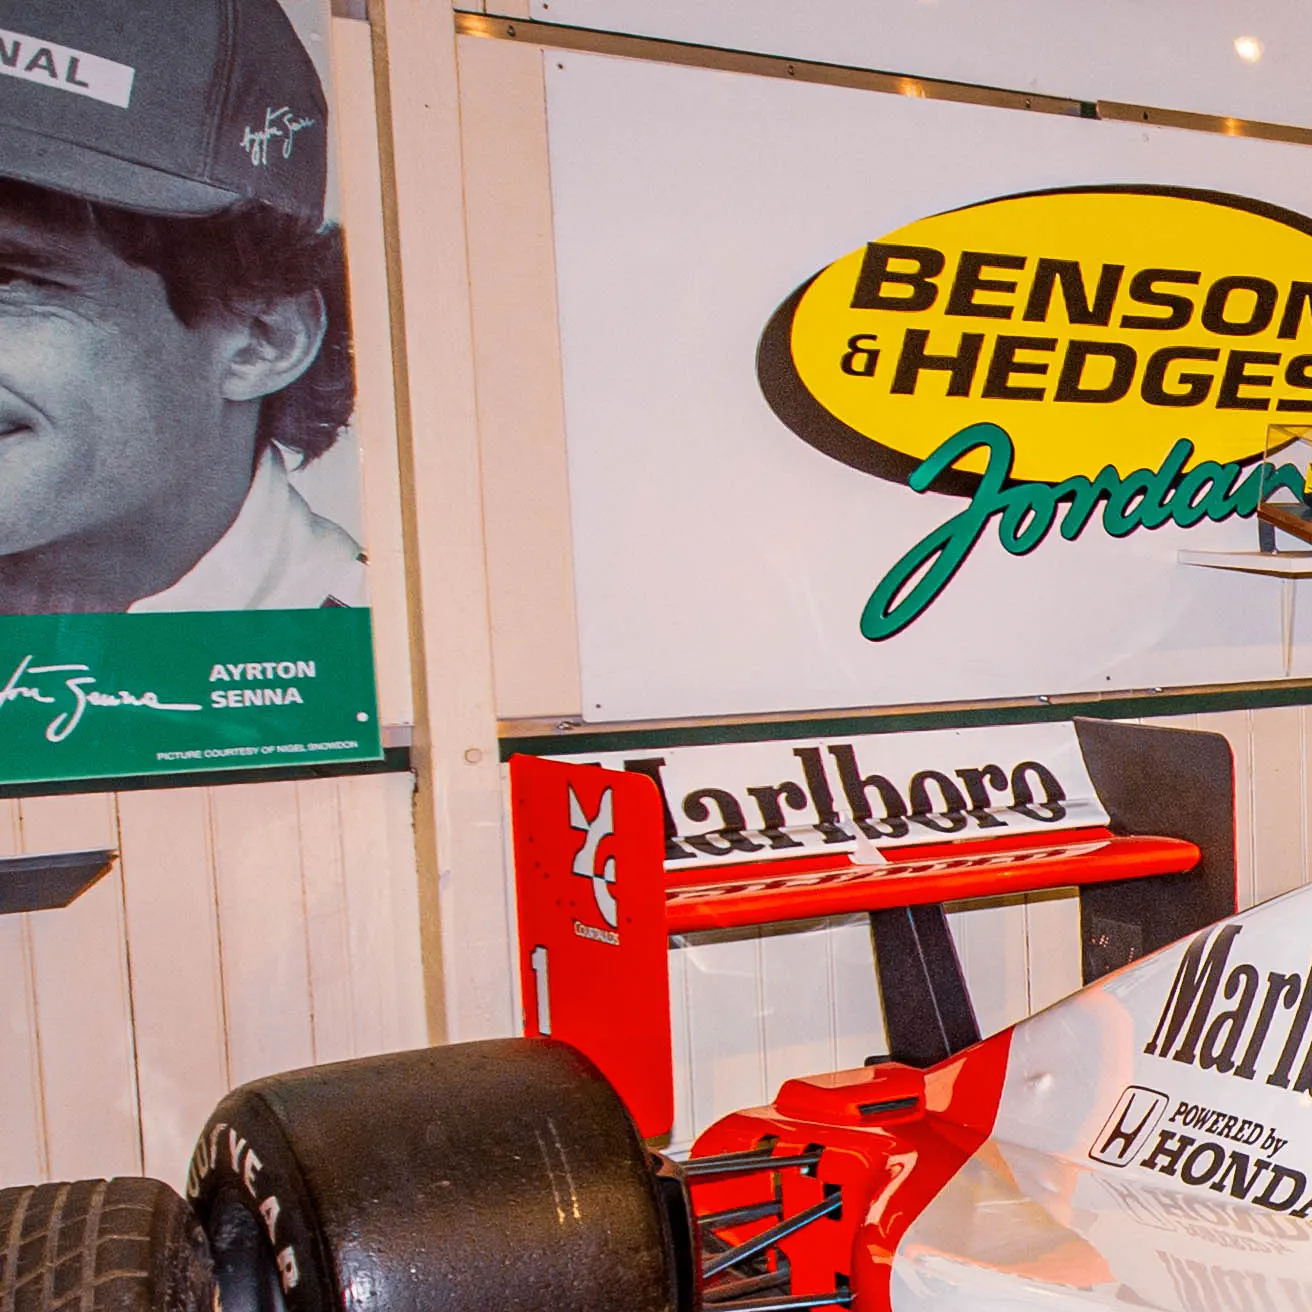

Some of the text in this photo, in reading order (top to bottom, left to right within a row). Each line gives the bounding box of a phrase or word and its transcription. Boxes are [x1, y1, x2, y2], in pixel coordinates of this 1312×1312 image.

[839, 333, 877, 377] &
[858, 422, 1303, 642] Jordan
[209, 661, 316, 682] AYRTON
[210, 687, 304, 708] SENNA
[157, 751, 202, 760] PICTURE
[261, 746, 275, 754] OF
[1170, 1100, 1289, 1159] POWERED by
